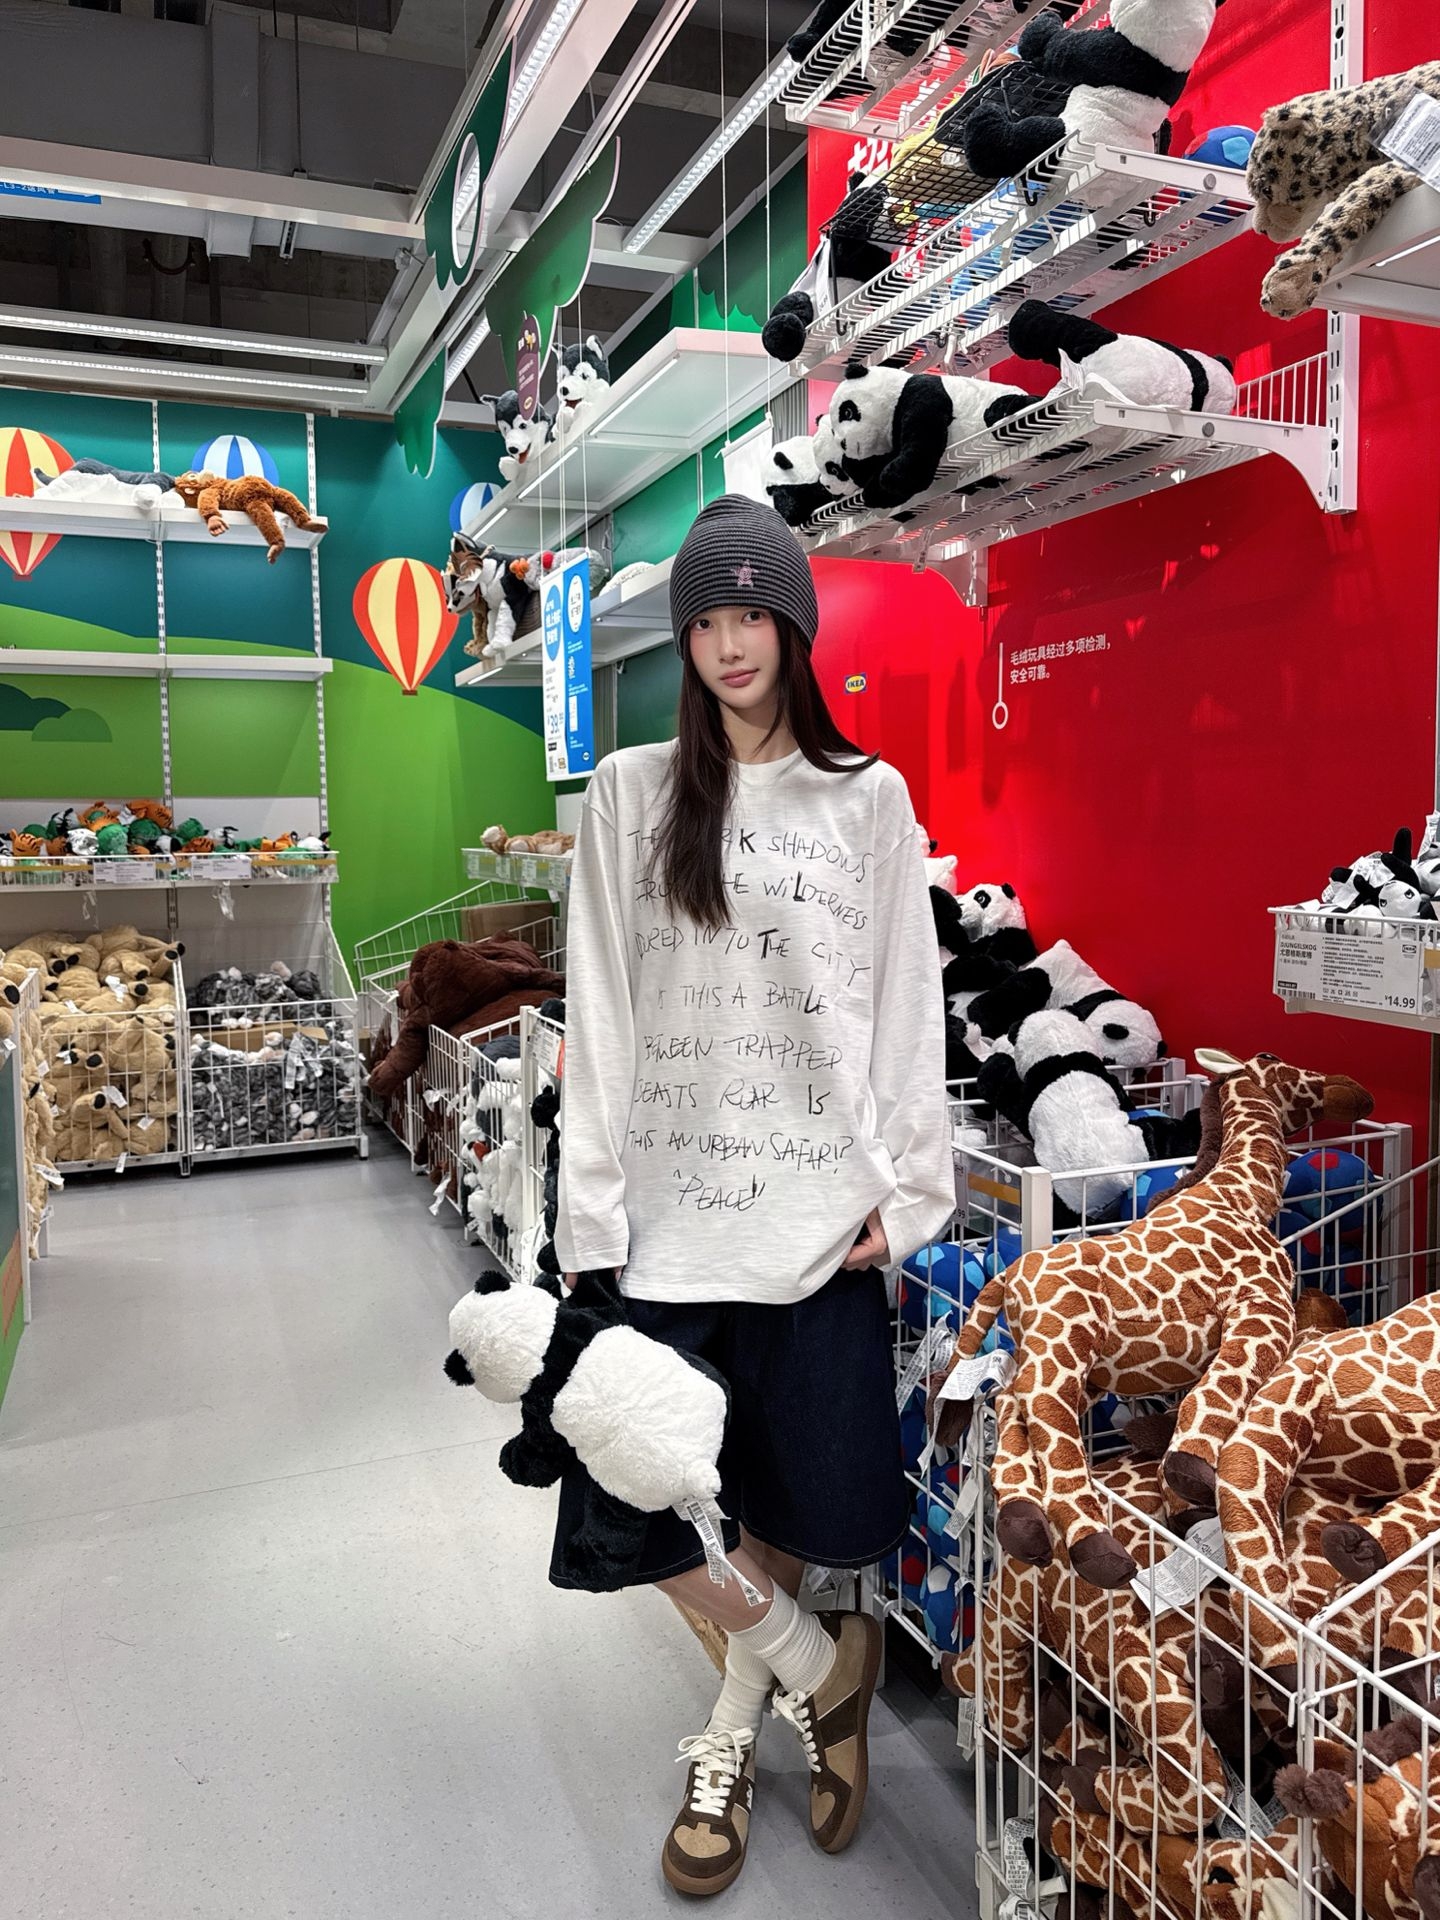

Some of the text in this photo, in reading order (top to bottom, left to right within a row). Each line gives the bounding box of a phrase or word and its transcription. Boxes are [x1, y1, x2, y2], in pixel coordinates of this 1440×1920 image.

[1010, 633, 1111, 666] 毛绒玩具经过多项检测，
[1010, 664, 1050, 684] 安全可靠。
[768, 831, 874, 883] SHADOWS
[757, 928, 790, 959] THE
[811, 942, 871, 986] CITY
[680, 982, 722, 1009] THIS
[732, 982, 747, 1008] A
[763, 981, 829, 1015] BATTLE
[723, 1032, 843, 1070] TRAPPED
[630, 1130, 657, 1151] THIS
[667, 1130, 694, 1151] AN
[699, 1133, 765, 1161] URBAN
